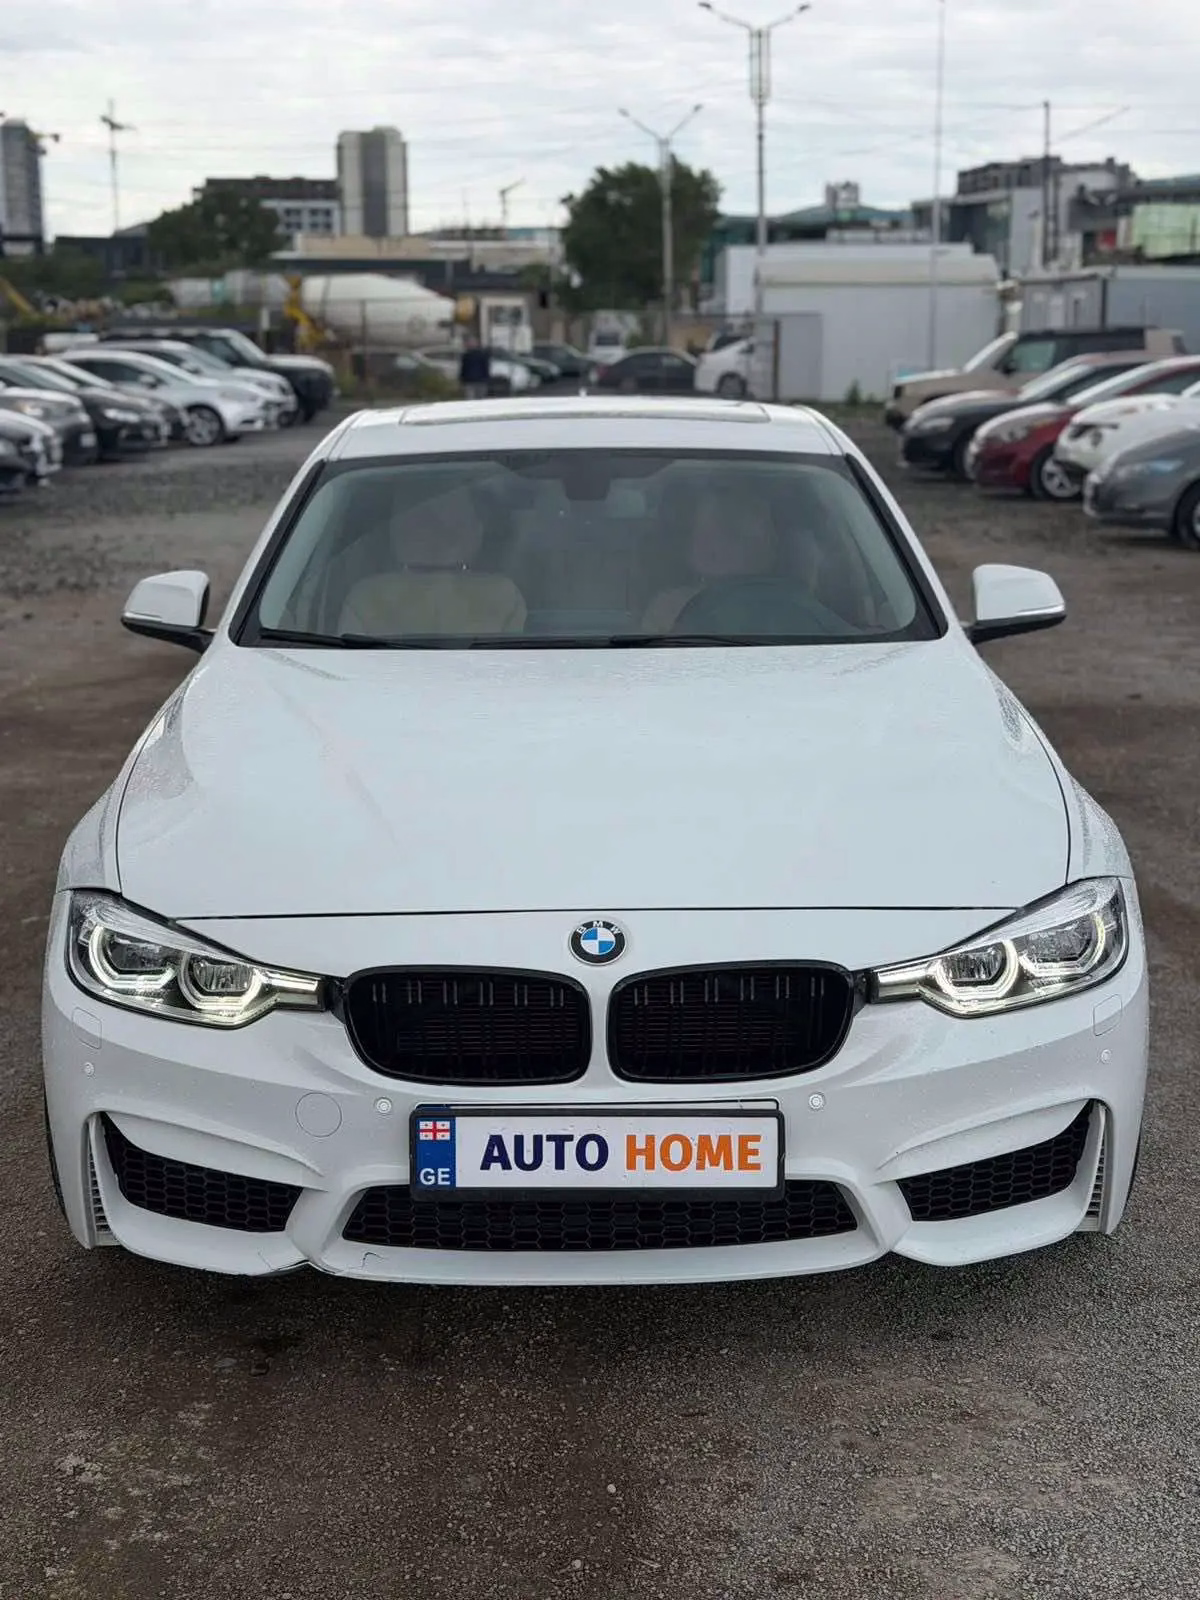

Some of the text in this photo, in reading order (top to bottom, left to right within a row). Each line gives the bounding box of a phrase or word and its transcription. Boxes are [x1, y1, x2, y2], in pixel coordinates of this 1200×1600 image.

[576, 920, 622, 935] BMW
[480, 1134, 762, 1172] AUTO HOME
[419, 1167, 451, 1186] GE
